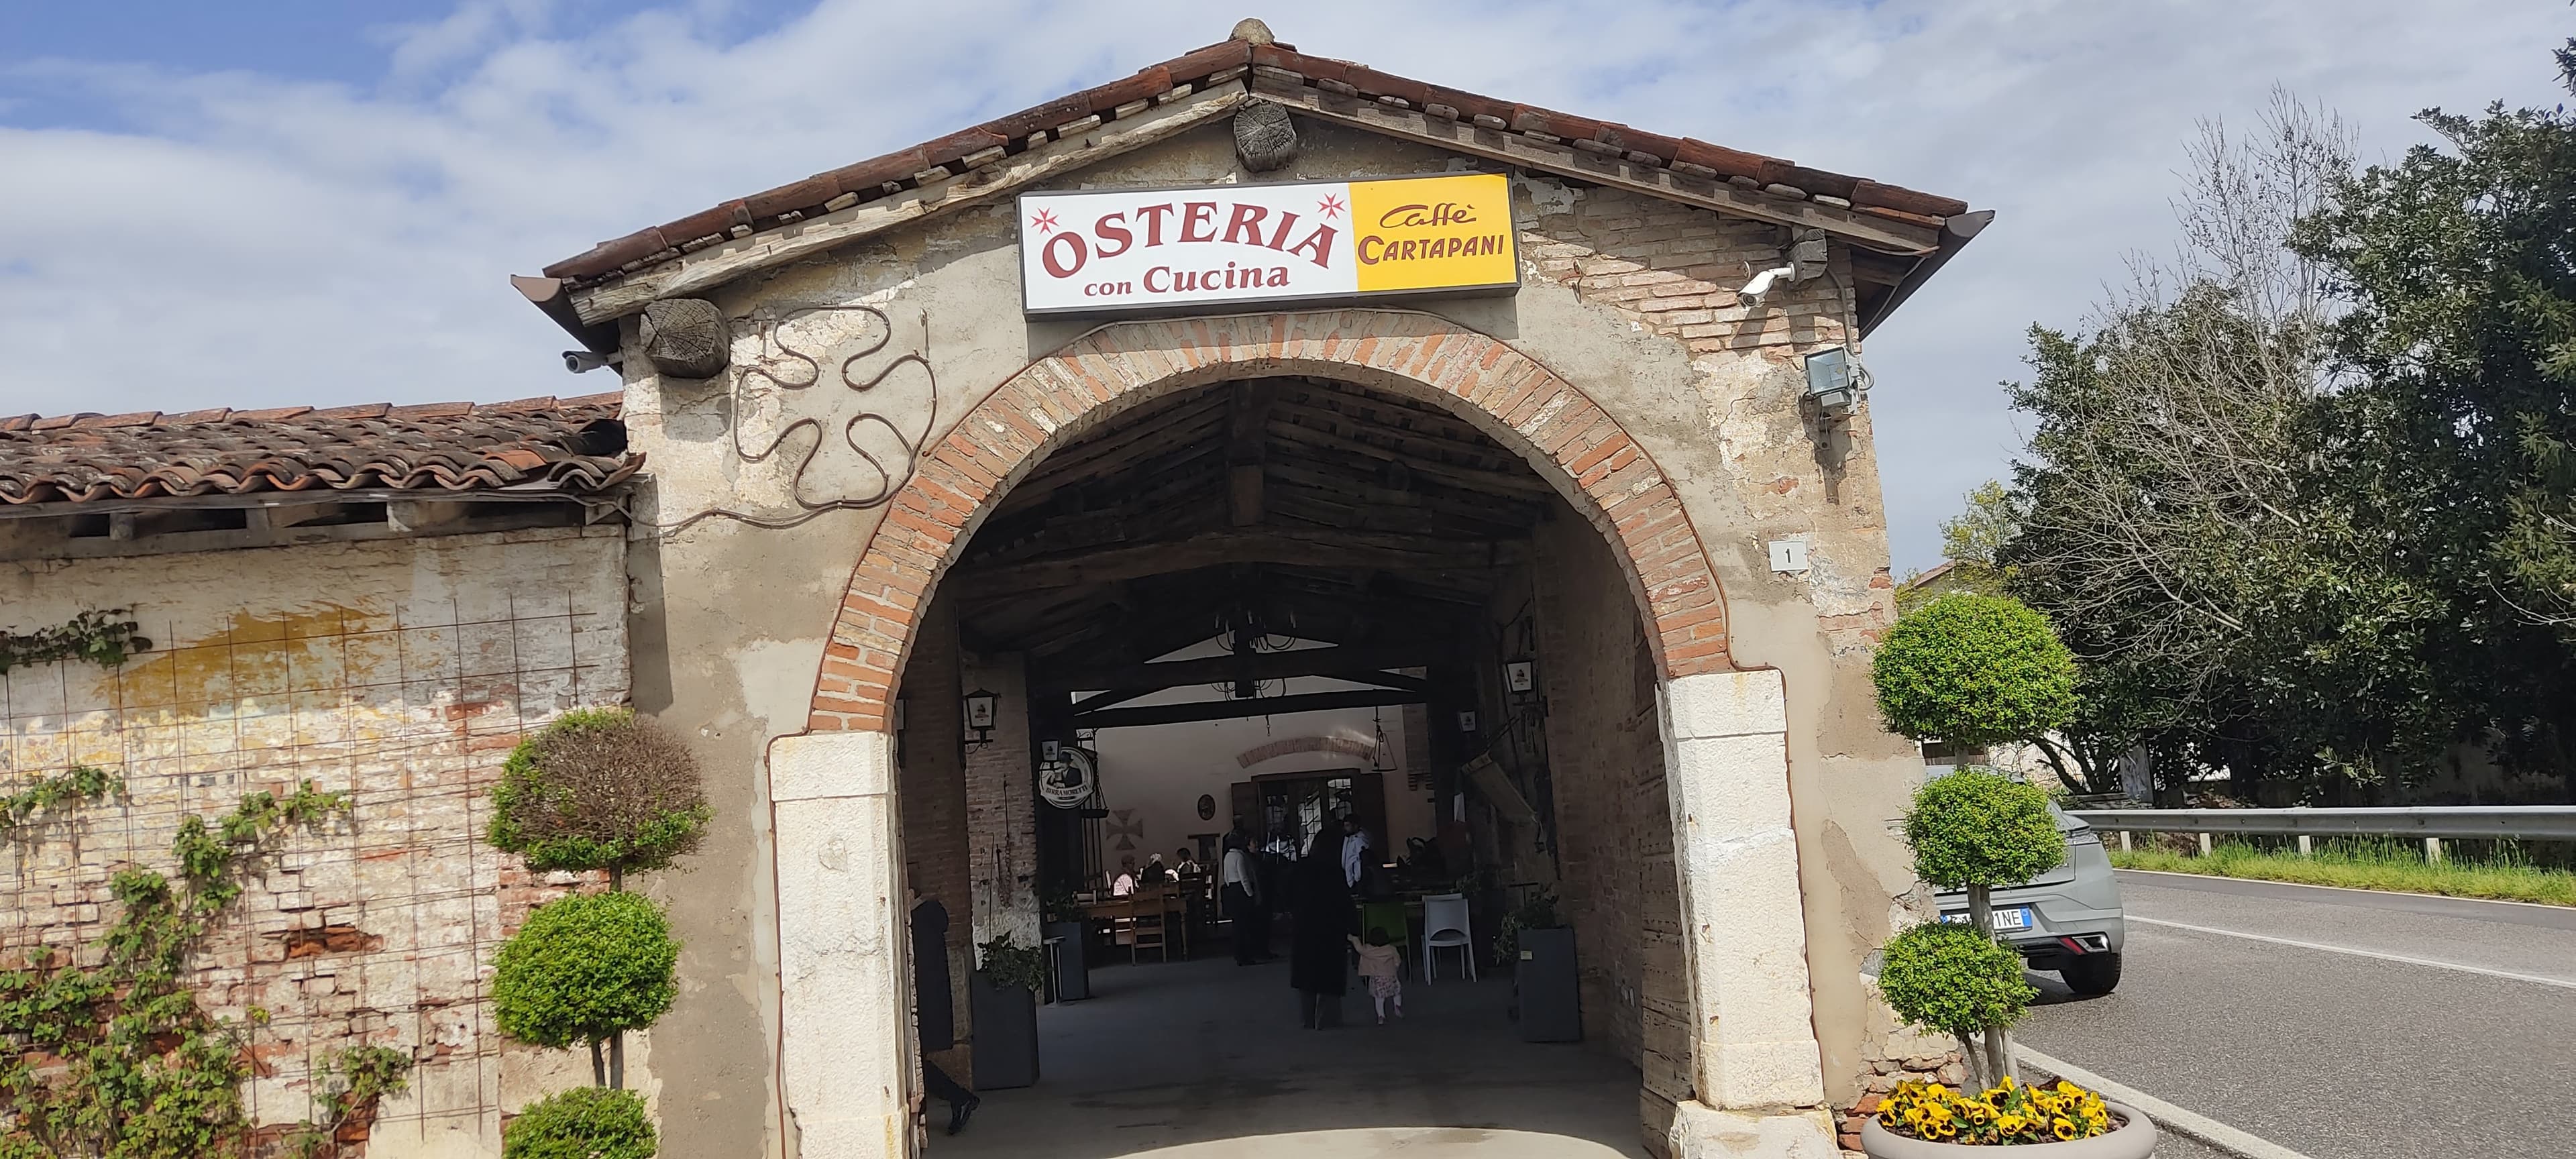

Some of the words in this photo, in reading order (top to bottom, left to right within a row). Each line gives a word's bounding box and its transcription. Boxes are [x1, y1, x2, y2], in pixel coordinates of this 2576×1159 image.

[1379, 203, 1477, 229] Caffè
[1042, 201, 1340, 278] OSTERIA
[1358, 235, 1504, 265] CARTAPANI
[1083, 281, 1133, 296] con
[1143, 261, 1291, 293] Cucina
[1785, 548, 1791, 563] 1
